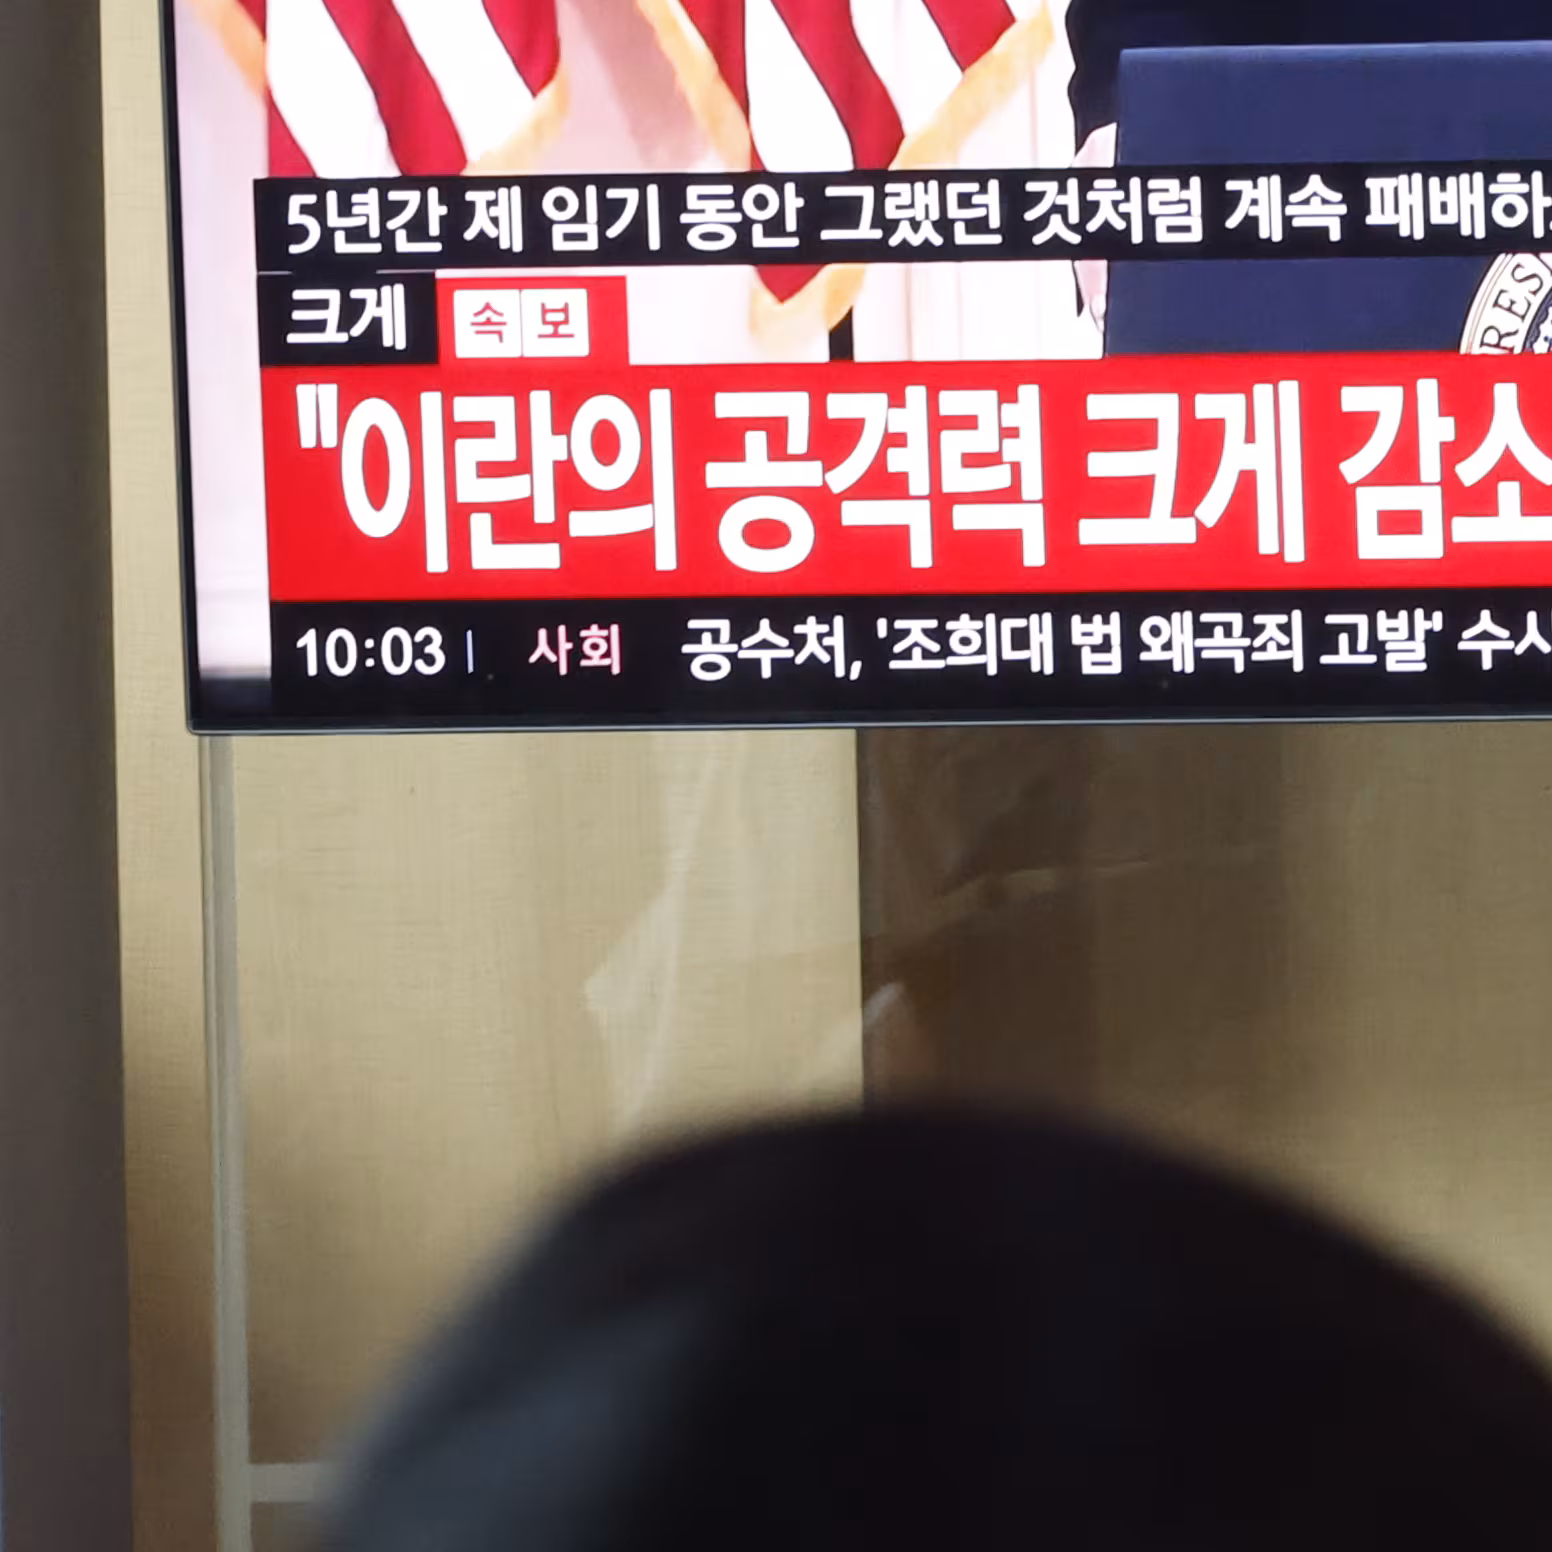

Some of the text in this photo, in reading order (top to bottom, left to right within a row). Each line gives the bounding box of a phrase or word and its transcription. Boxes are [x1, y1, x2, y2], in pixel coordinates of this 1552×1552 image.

[287, 186, 448, 255] 5년간
[462, 185, 523, 253] 제
[541, 183, 661, 252] 임기
[679, 181, 805, 252] 동안
[819, 178, 1003, 248] 그랬던
[1023, 175, 1203, 246] 것처럼
[1224, 173, 1348, 243] 계속
[286, 283, 407, 351] 크게
[470, 302, 576, 342] 속보
[296, 383, 678, 573] "이란의
[705, 383, 1046, 573] 공격력
[1077, 379, 1306, 563] 크게
[296, 626, 446, 677] 10:03
[528, 623, 622, 676] 사회
[681, 614, 863, 682] 공수처,
[876, 611, 1055, 676] '조희대
[1070, 611, 1122, 675] 법
[1139, 609, 1304, 674] 왜곡죄
[1319, 607, 1443, 673] 고발'
